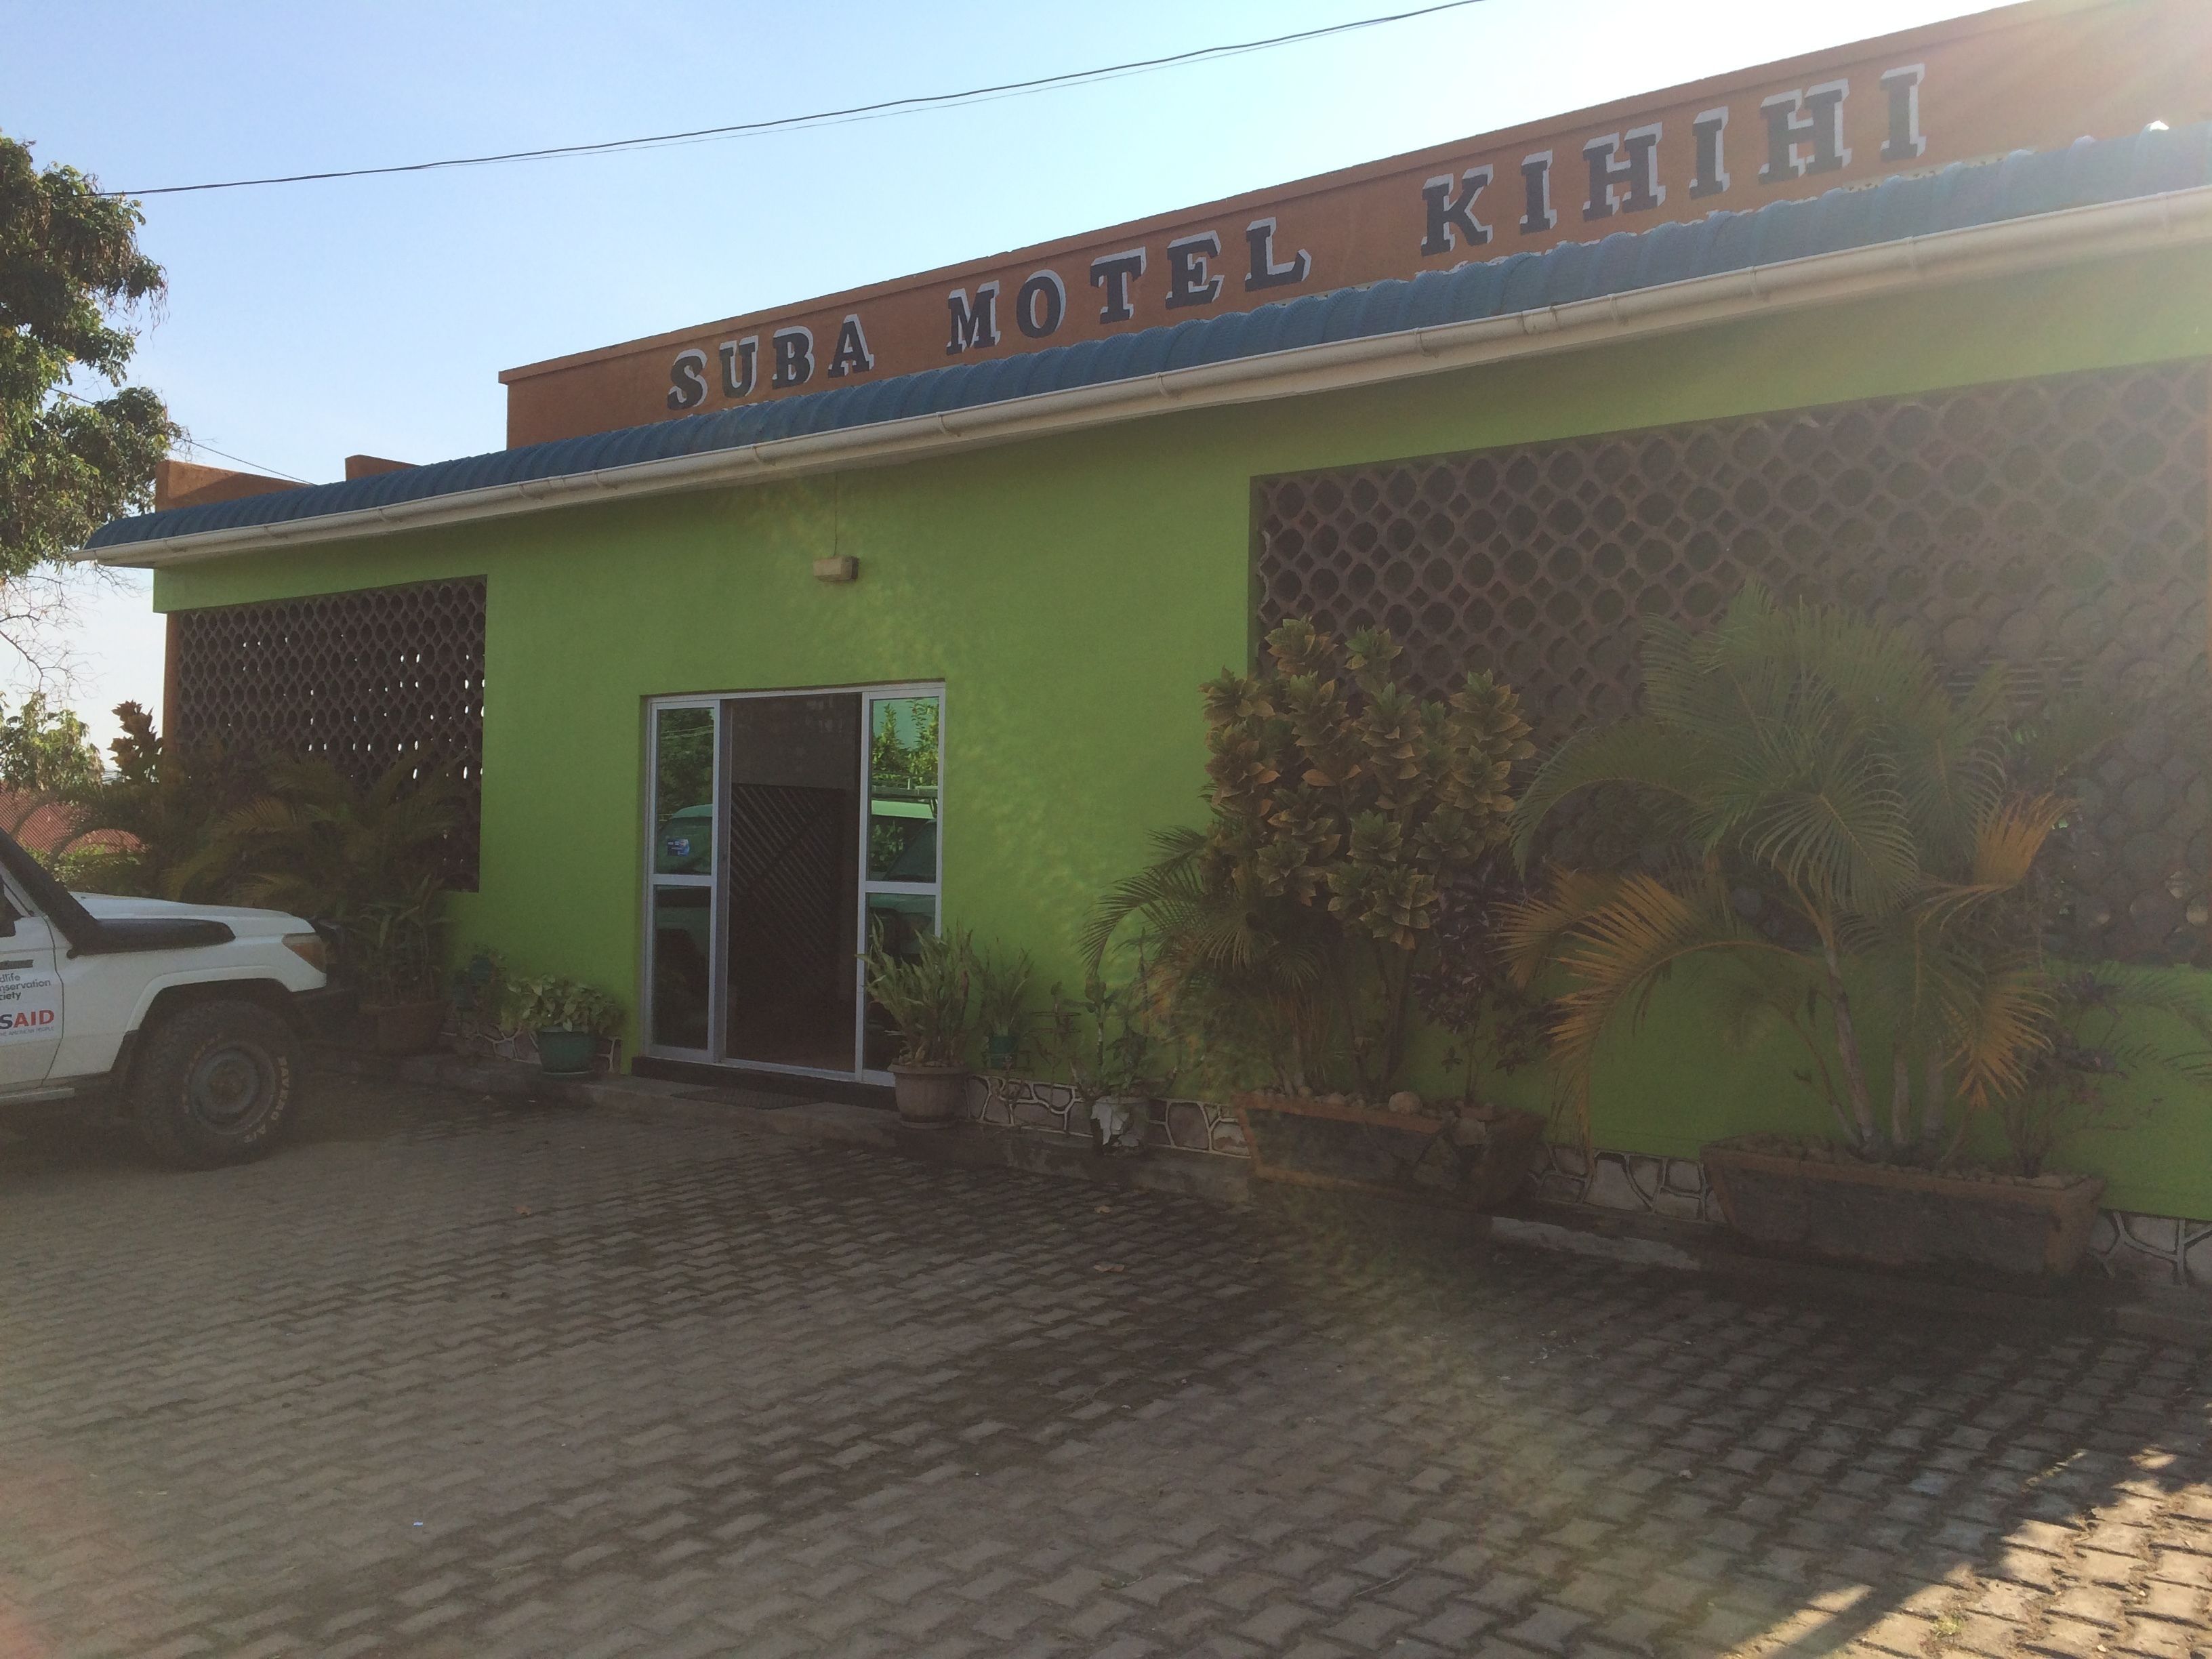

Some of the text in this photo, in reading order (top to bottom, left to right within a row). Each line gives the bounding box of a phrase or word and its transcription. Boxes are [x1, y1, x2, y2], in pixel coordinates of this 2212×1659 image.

[667, 62, 1927, 411] SUBA MOTEL KIHIHI
